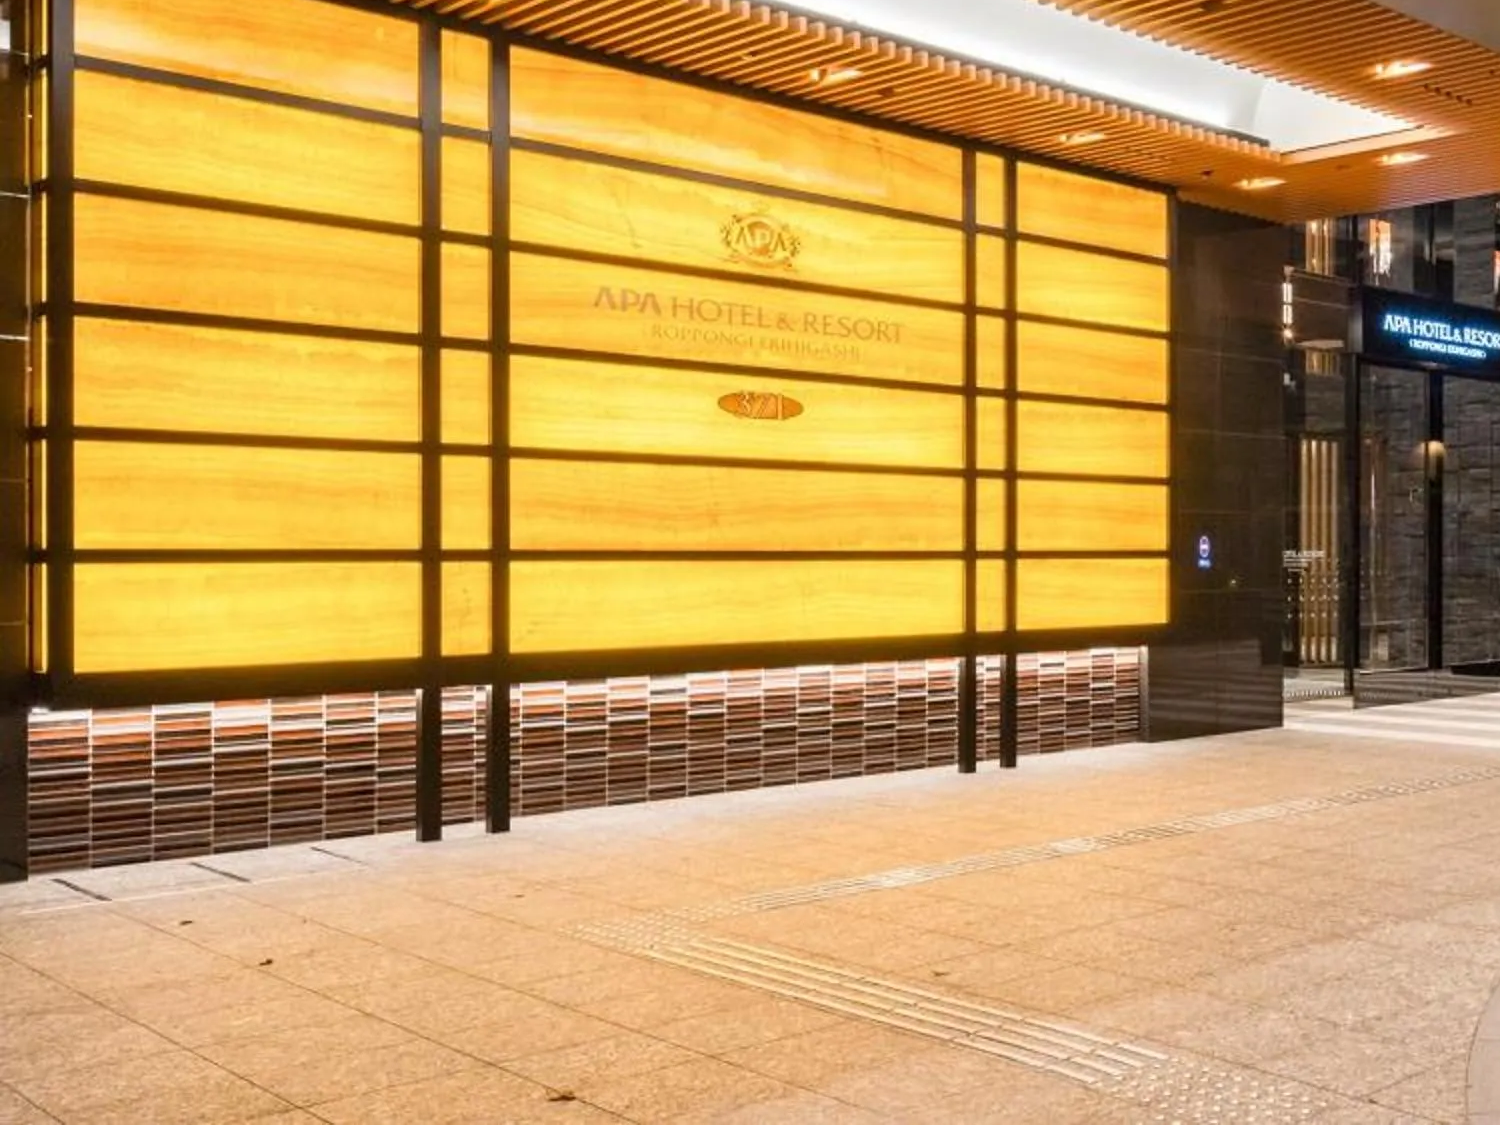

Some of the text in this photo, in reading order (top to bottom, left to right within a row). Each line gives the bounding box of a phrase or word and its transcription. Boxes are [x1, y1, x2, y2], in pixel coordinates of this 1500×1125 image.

[593, 286, 905, 344] APA HOTEL & RESORT
[1384, 314, 1411, 333] APA
[1413, 319, 1452, 341] HOTEL
